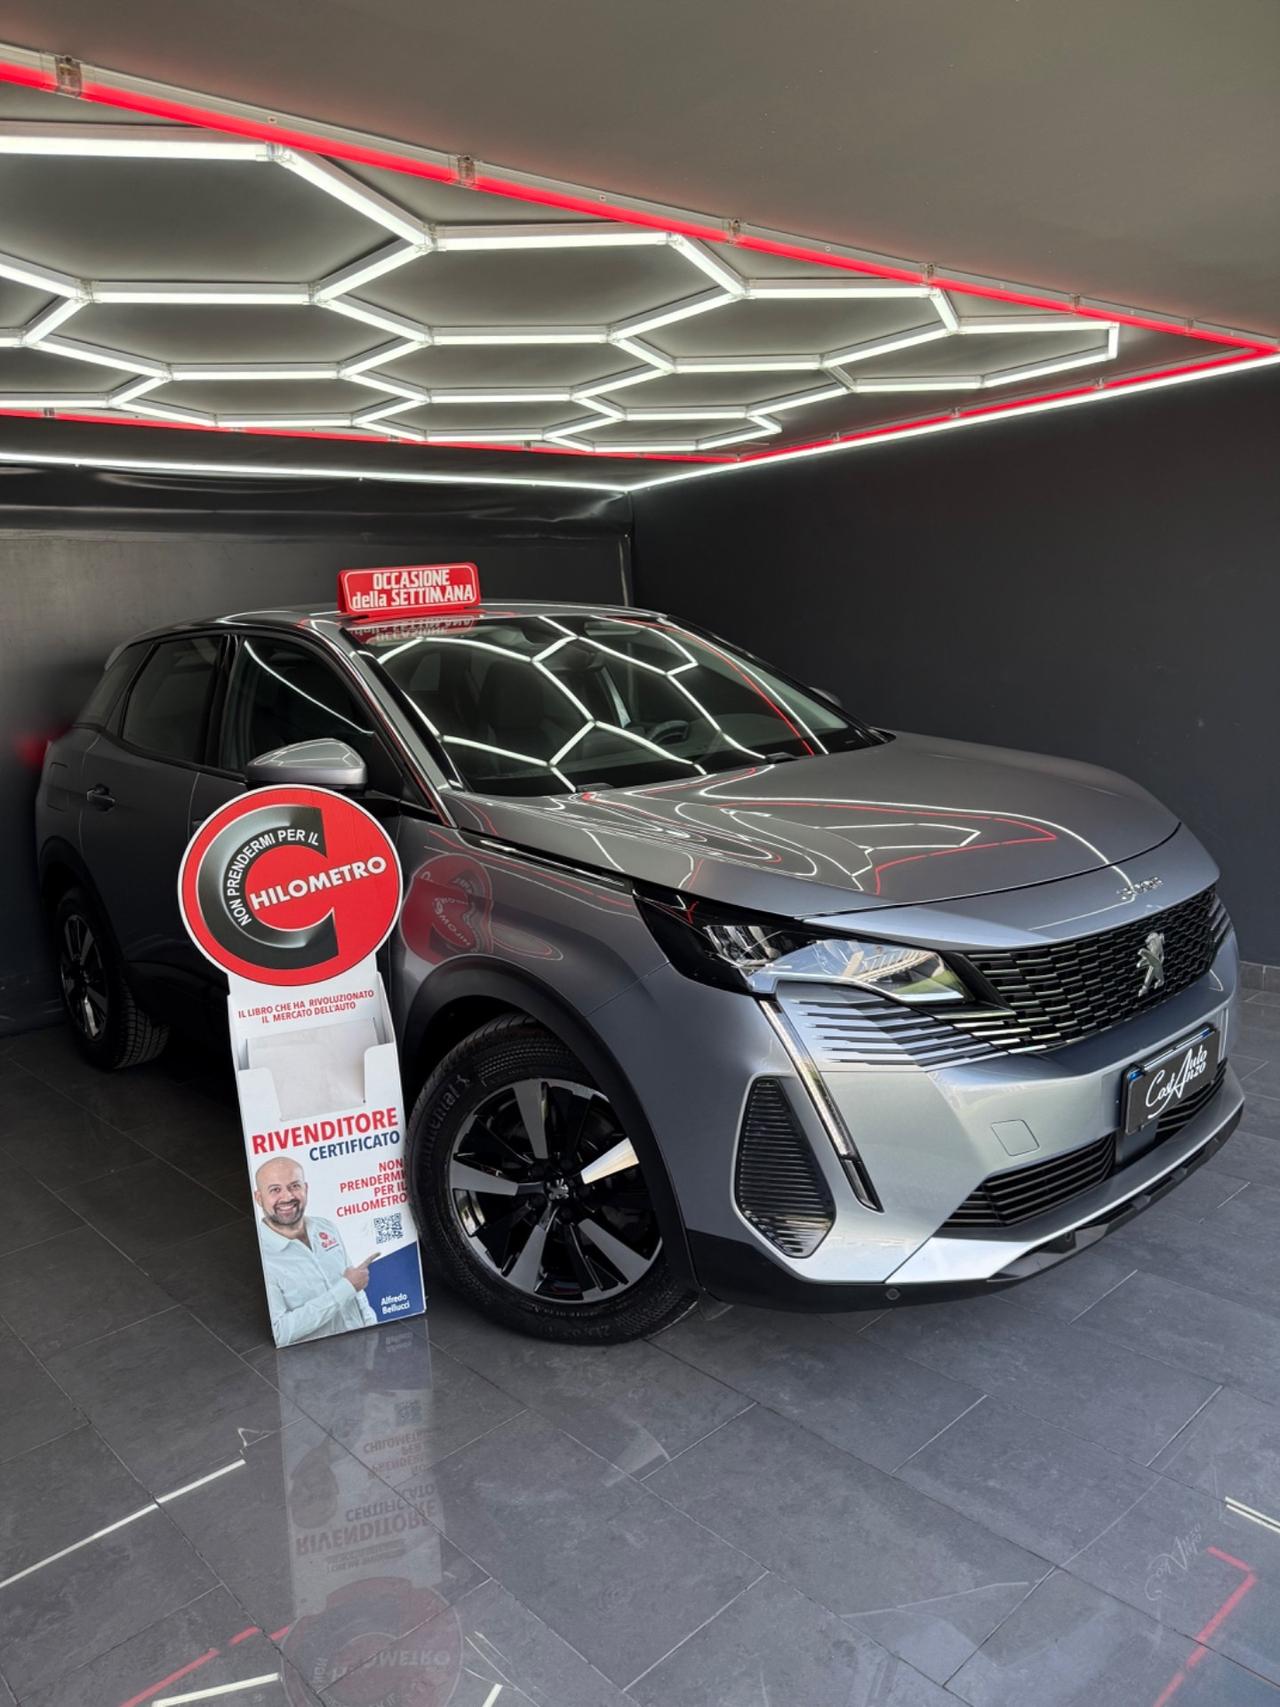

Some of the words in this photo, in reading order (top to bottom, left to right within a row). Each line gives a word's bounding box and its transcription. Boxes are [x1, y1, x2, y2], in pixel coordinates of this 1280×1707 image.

[373, 569, 450, 590] OCCASIONE
[352, 591, 387, 609] della
[391, 584, 473, 607] SETTIMANA
[277, 829, 306, 842] PER
[308, 832, 320, 846] IL
[227, 833, 276, 896] PRENDERMI
[229, 899, 252, 926] NON
[238, 1010, 247, 1019] IL
[248, 1006, 273, 1017] LIBRO
[275, 1003, 292, 1012] CHE
[293, 1000, 306, 1009] HA
[308, 990, 375, 1007] RIVOLUZIONATO
[262, 1016, 269, 1024] IL
[273, 1008, 313, 1022] MERCATO
[314, 1002, 356, 1016] DELL'AUTO
[252, 1107, 399, 1154] RIVENDITORE
[309, 1130, 400, 1162] CERTIFICATO
[378, 1158, 404, 1172] NON
[339, 1169, 407, 1193] PRENDERMI
[374, 1184, 395, 1197] PER
[397, 1181, 408, 1192] IL
[336, 1193, 408, 1217] CHILOMETRO
[381, 1293, 408, 1306] Alfredo
[381, 1300, 410, 1315] Bellucci
